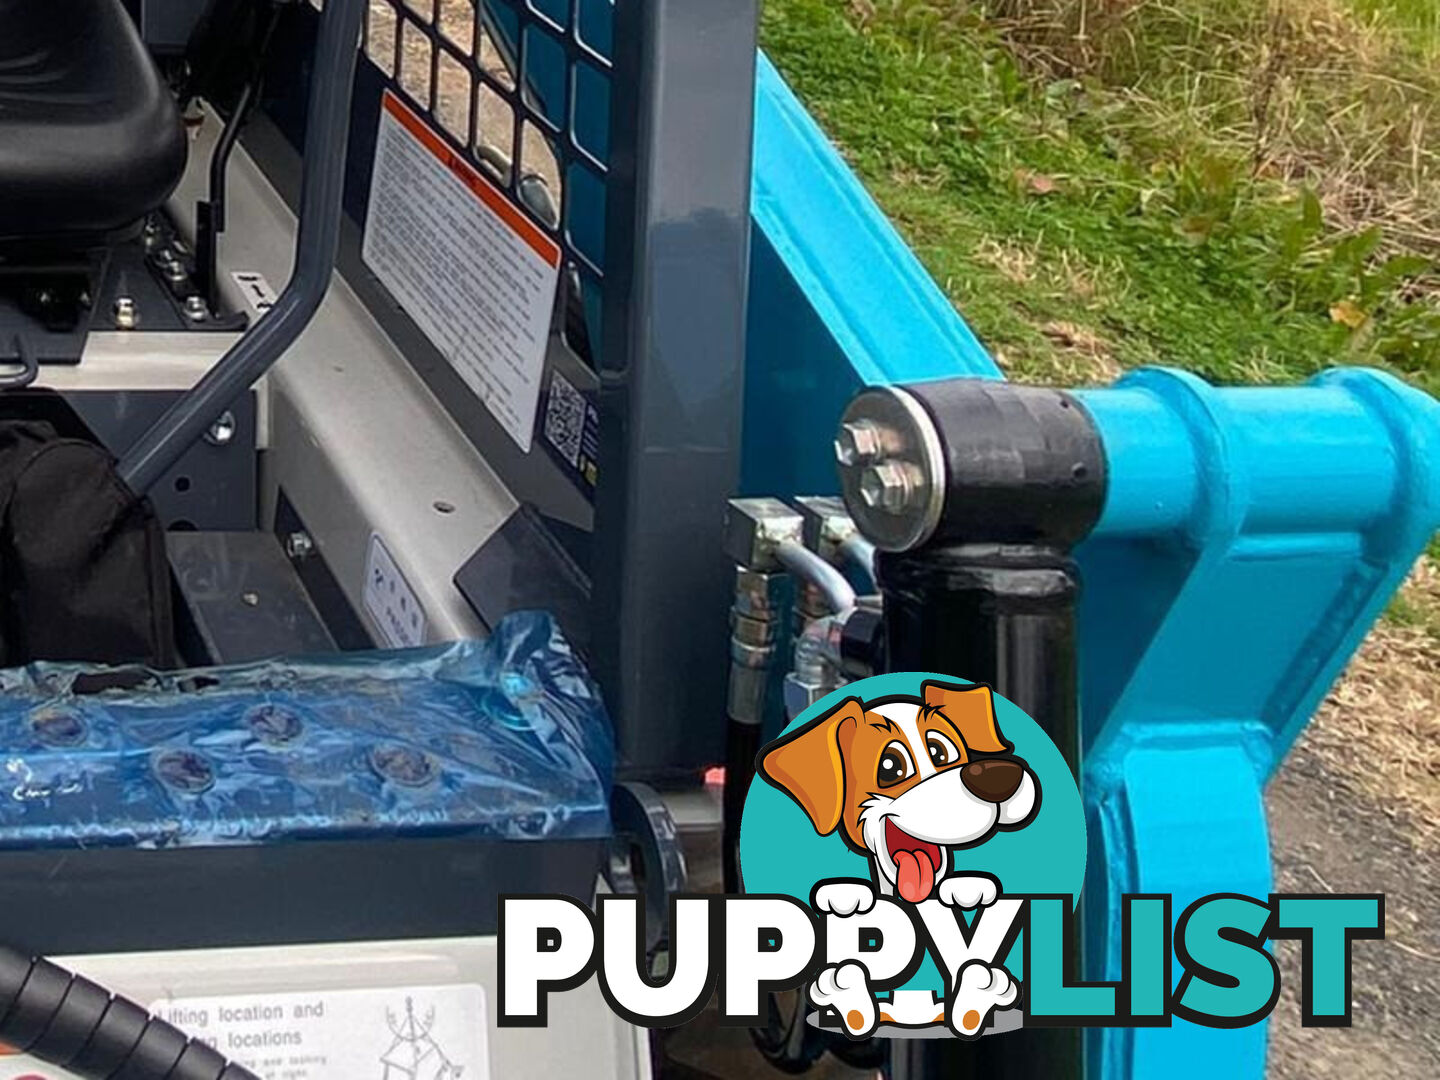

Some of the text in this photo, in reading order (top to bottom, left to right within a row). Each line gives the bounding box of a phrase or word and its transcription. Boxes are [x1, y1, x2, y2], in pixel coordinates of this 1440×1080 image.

[218, 1003, 284, 1023] location
[293, 1000, 325, 1018] and
[227, 1029, 303, 1049] locations
